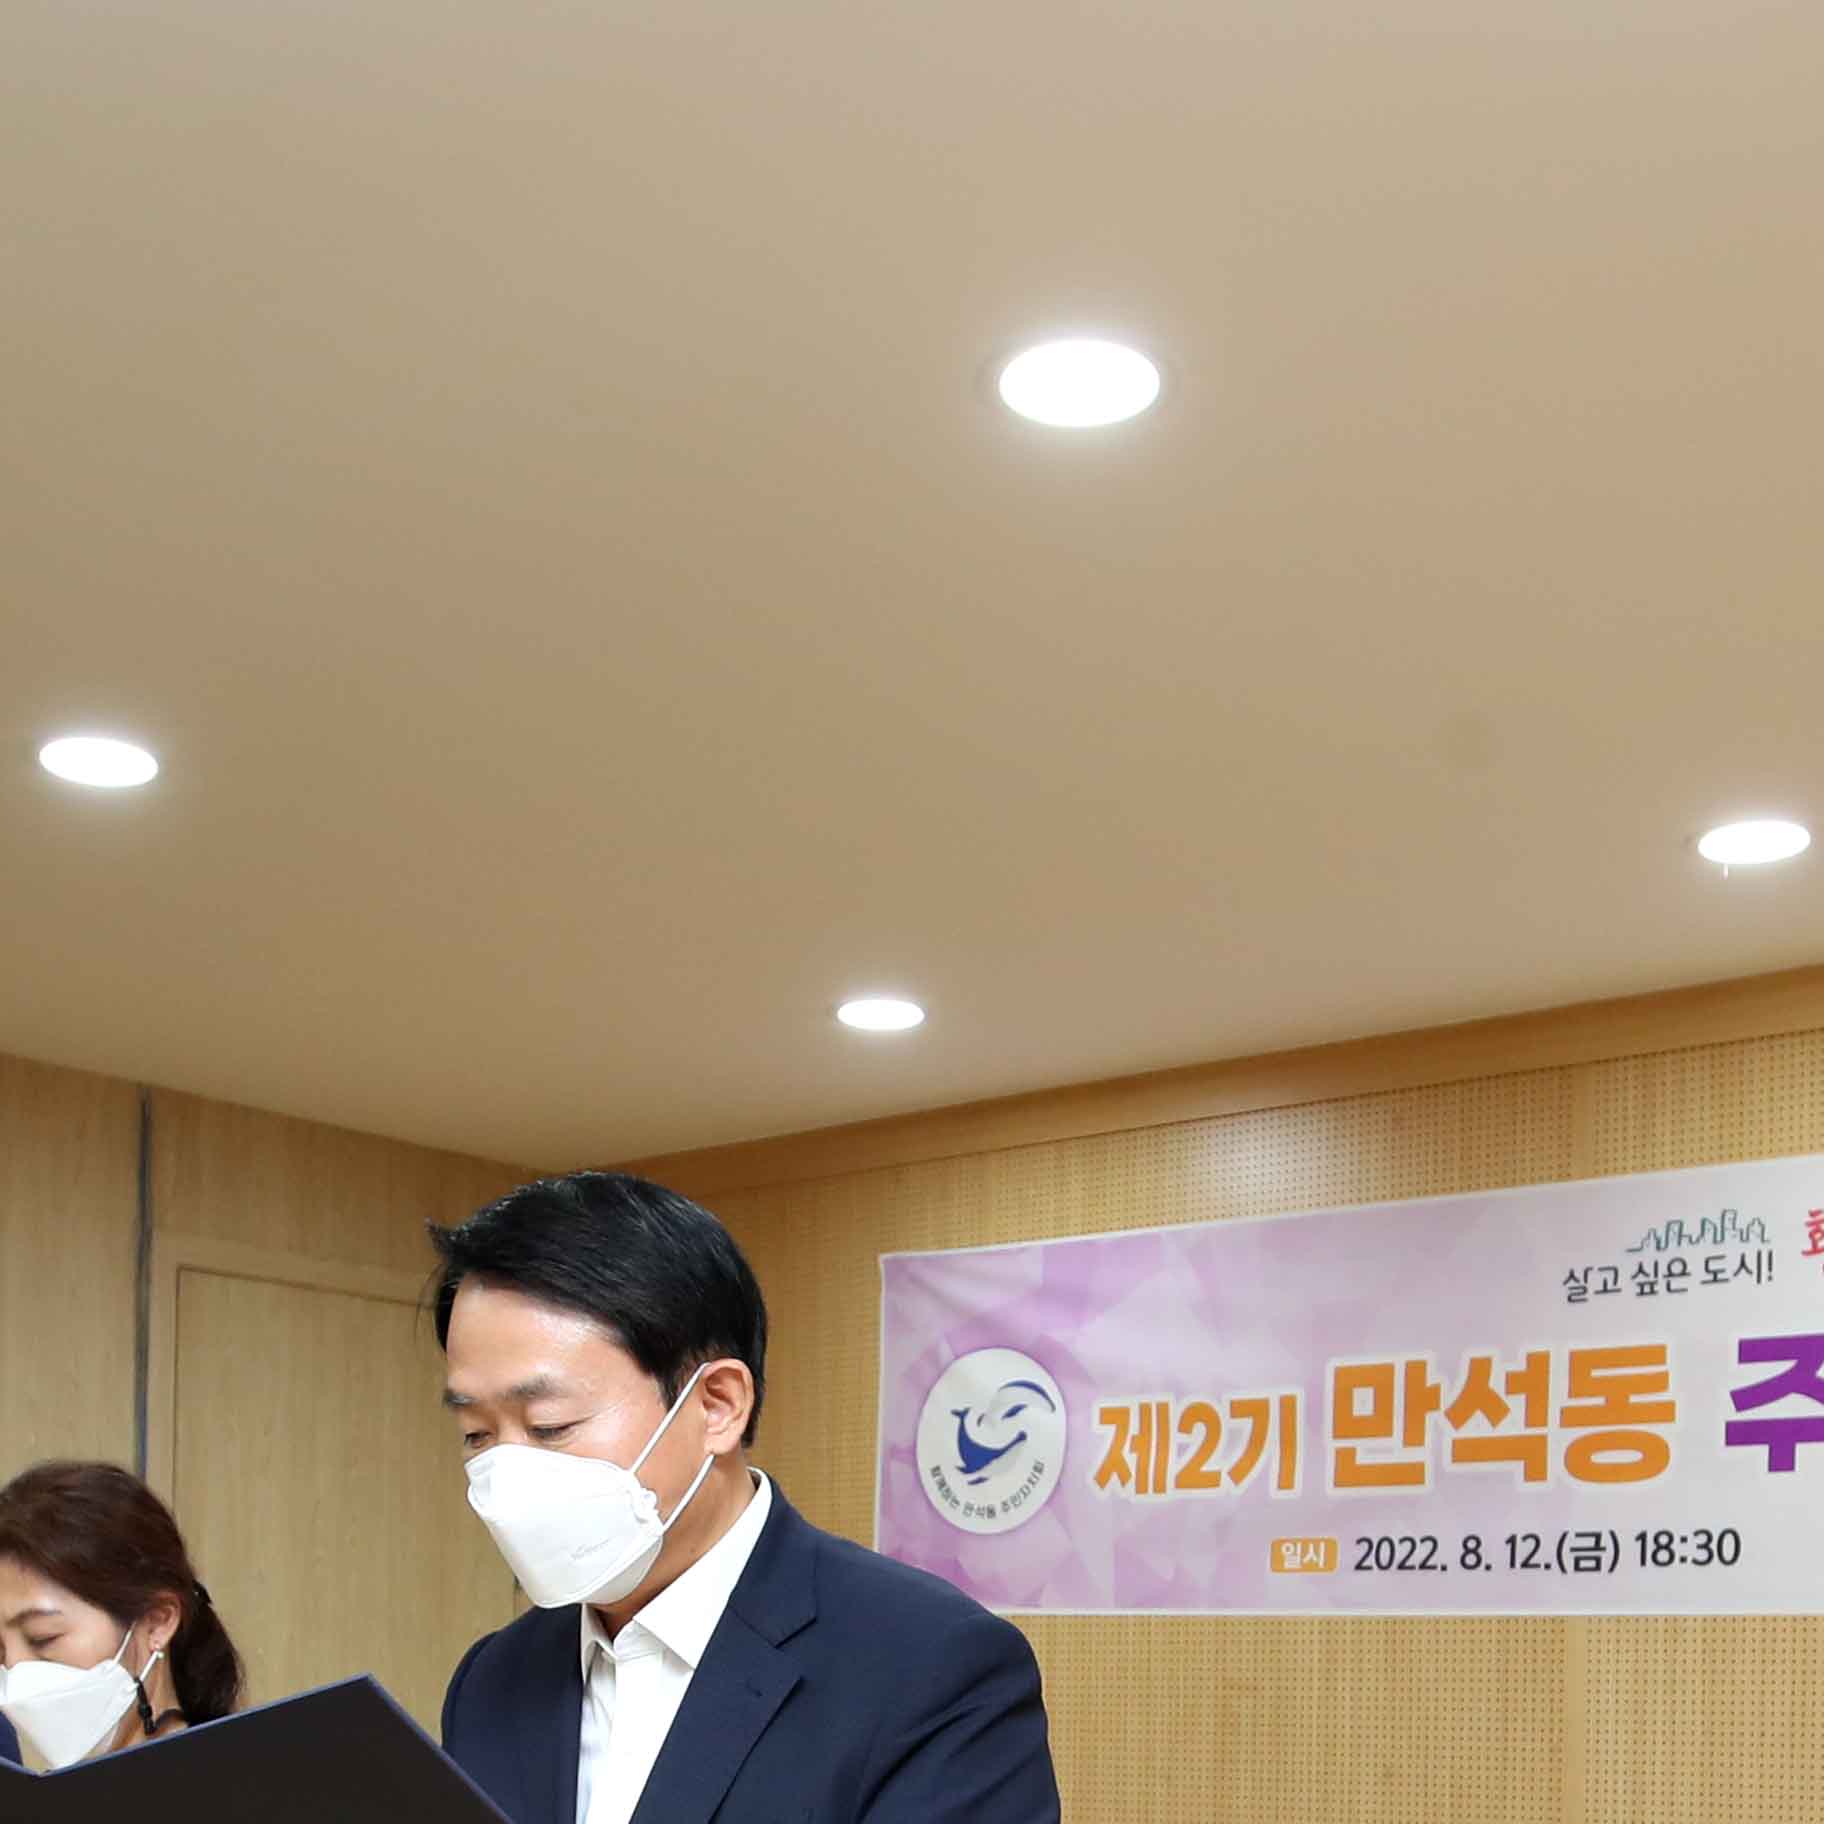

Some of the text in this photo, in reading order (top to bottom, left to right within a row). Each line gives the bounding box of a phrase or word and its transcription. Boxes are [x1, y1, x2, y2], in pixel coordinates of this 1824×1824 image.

[1561, 1248, 1775, 1303] 살고 싶은 도시!
[1093, 1394, 1297, 1495] 제2기
[1332, 1343, 1677, 1489] 만석동
[1280, 1528, 1741, 1574] 일시 2022. 8. 12.(금) 18:30
